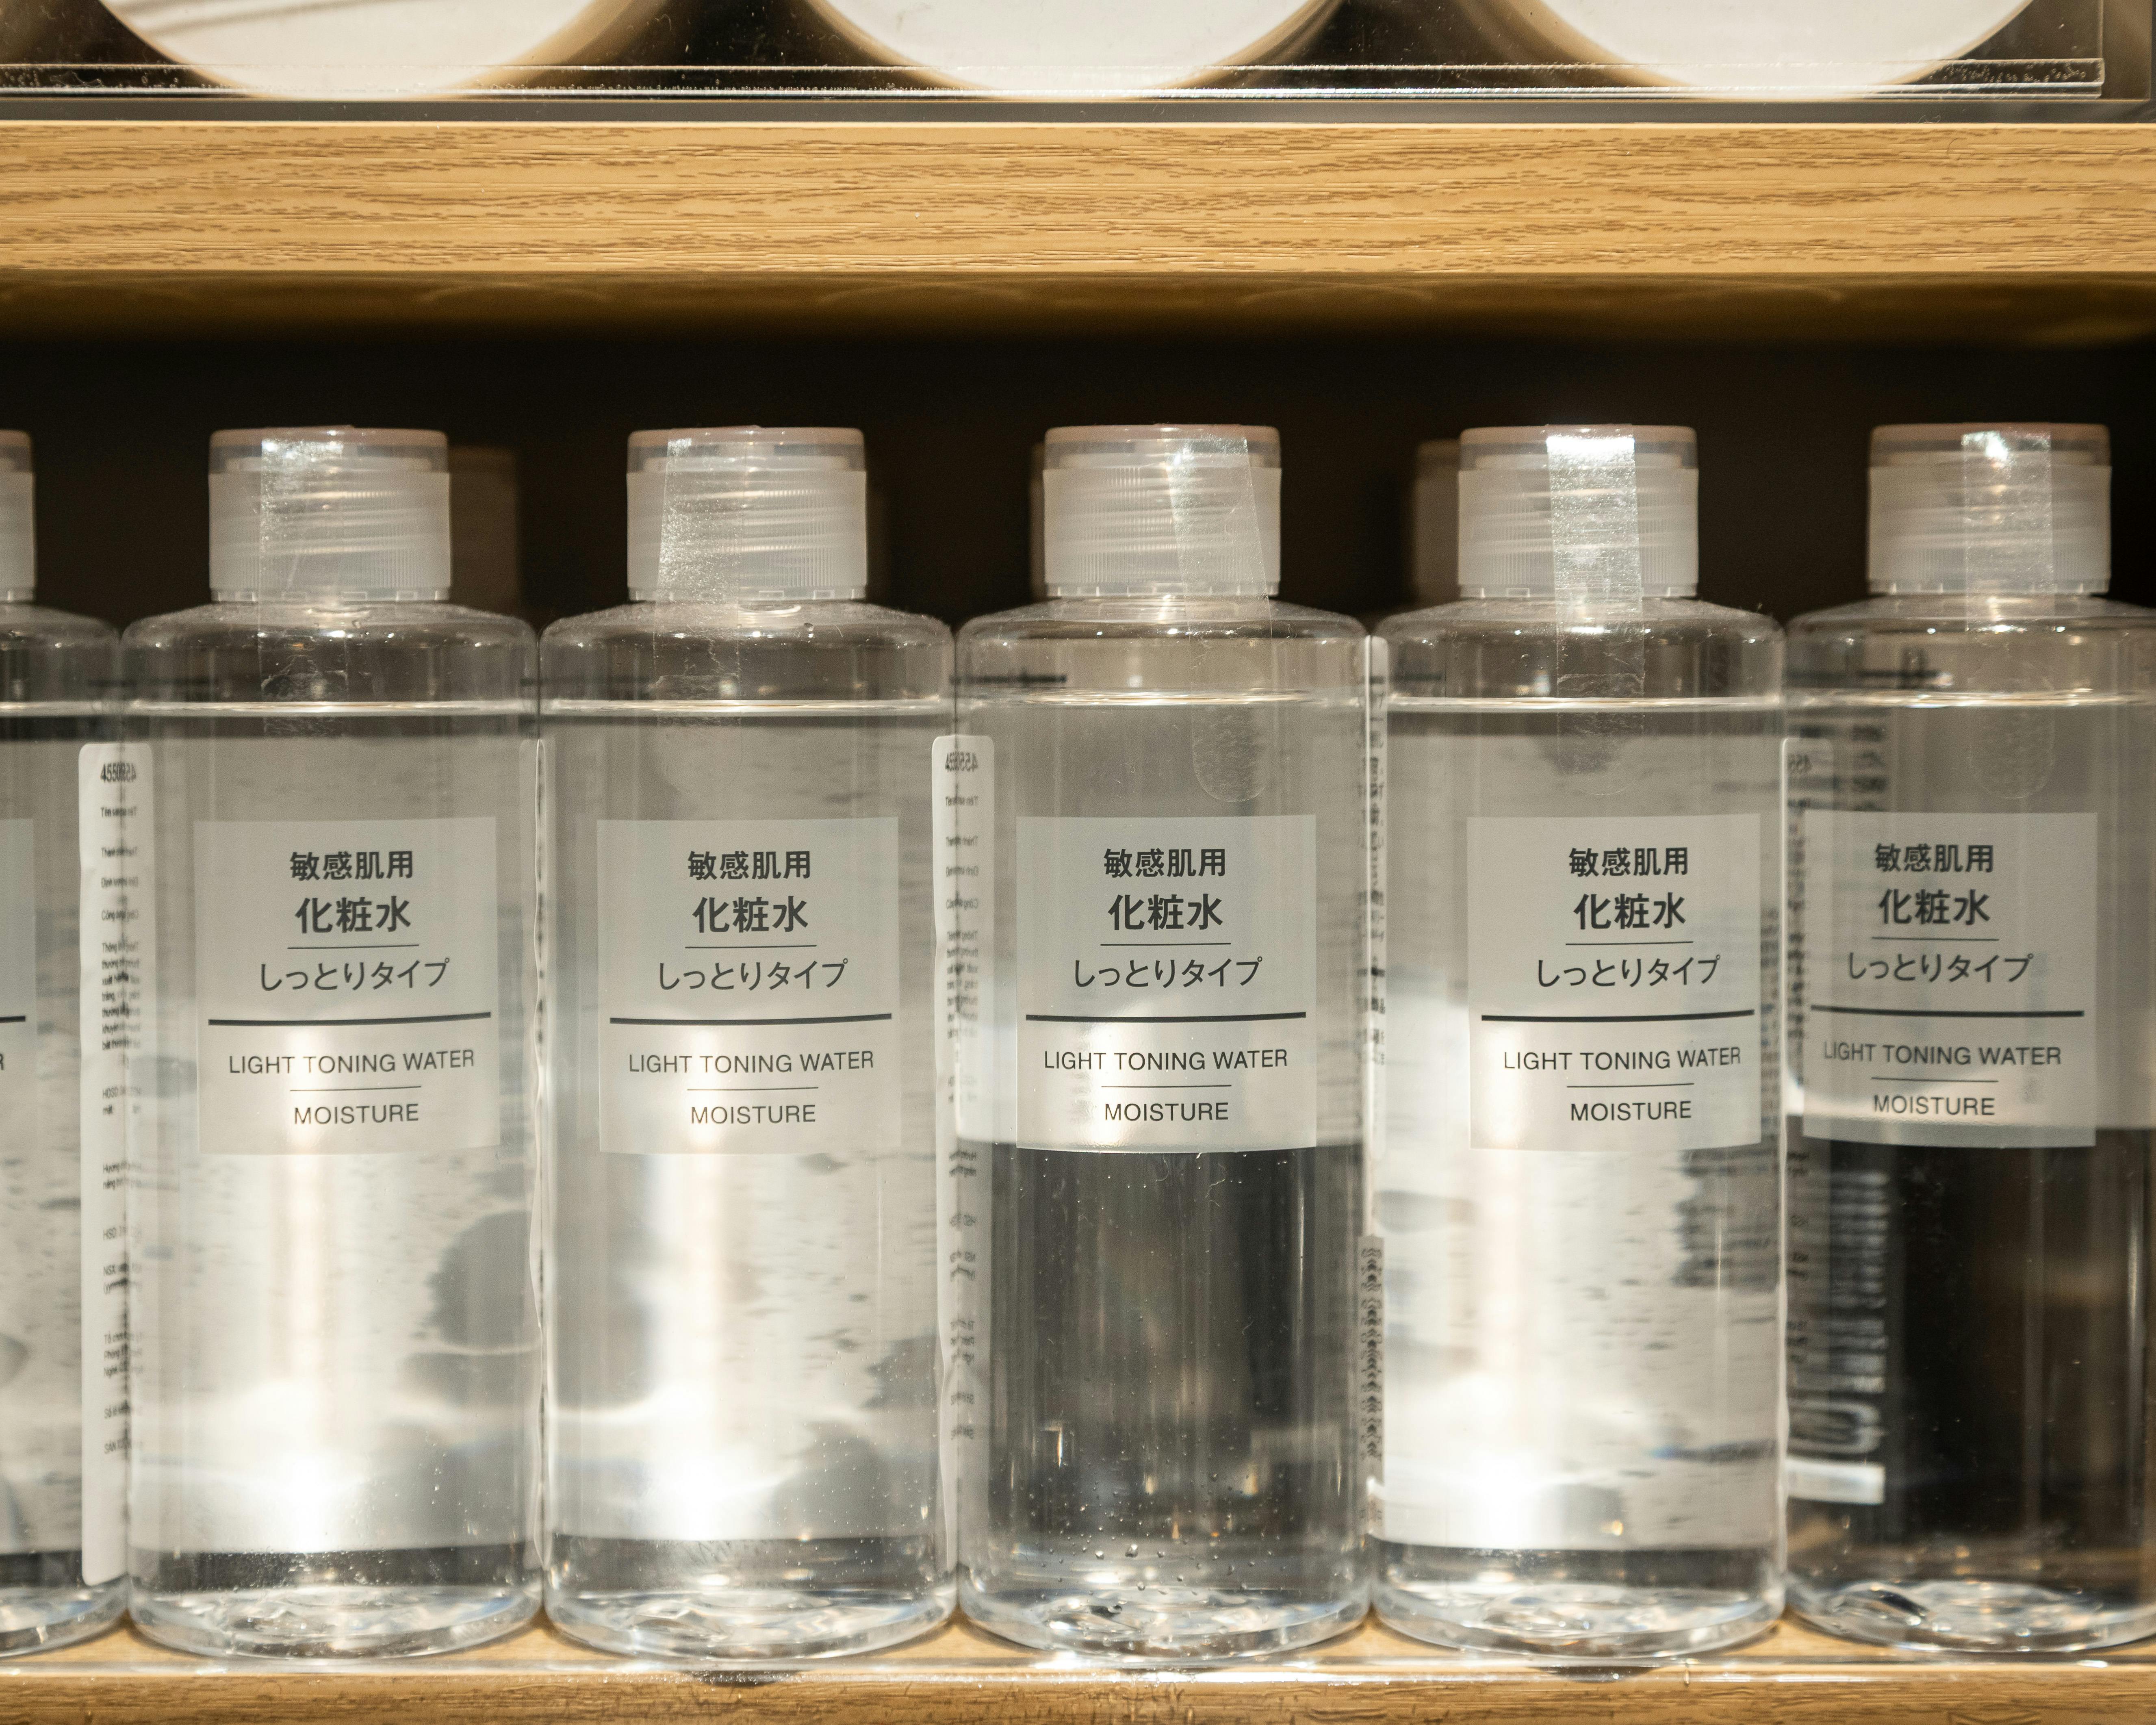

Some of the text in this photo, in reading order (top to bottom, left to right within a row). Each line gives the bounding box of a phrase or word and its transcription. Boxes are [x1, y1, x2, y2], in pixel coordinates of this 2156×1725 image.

[290, 851, 413, 881] 敏感肌用
[688, 851, 810, 880] 敏感肌用
[1104, 848, 1225, 878] 敏感肌用
[1568, 847, 1688, 877] 敏感肌用
[1875, 843, 1993, 873] 敏感肌用
[295, 896, 411, 933] 化粧水
[692, 896, 808, 933] 化粧水
[1108, 894, 1223, 931] 化粧水
[1573, 892, 1686, 930] 化粧水
[1878, 889, 1990, 926] 化粧水
[261, 957, 450, 991] しっとりタイプ
[660, 958, 848, 991] しっとりタイプ
[1075, 956, 1262, 988] しっとりタイプ
[1538, 954, 1720, 987] しっとりタイプ
[1848, 952, 2034, 983] しっとりタイプ
[229, 1049, 474, 1074] LIGHT TONING WATER
[629, 1050, 874, 1074] LIGHT TONING WATER
[1044, 1048, 1288, 1071] LIGHT TONING WATER
[1504, 1046, 1741, 1071] LIGHT TONING WATER
[1824, 1042, 2061, 1065] LIGHT TONING WATER
[295, 1103, 419, 1124] MOISTURE
[692, 1104, 816, 1124] MOISTURE
[1105, 1102, 1228, 1122] MOISTURE
[1571, 1100, 1692, 1121] MOISTURE
[1874, 1095, 1995, 1115] MOISTURE
